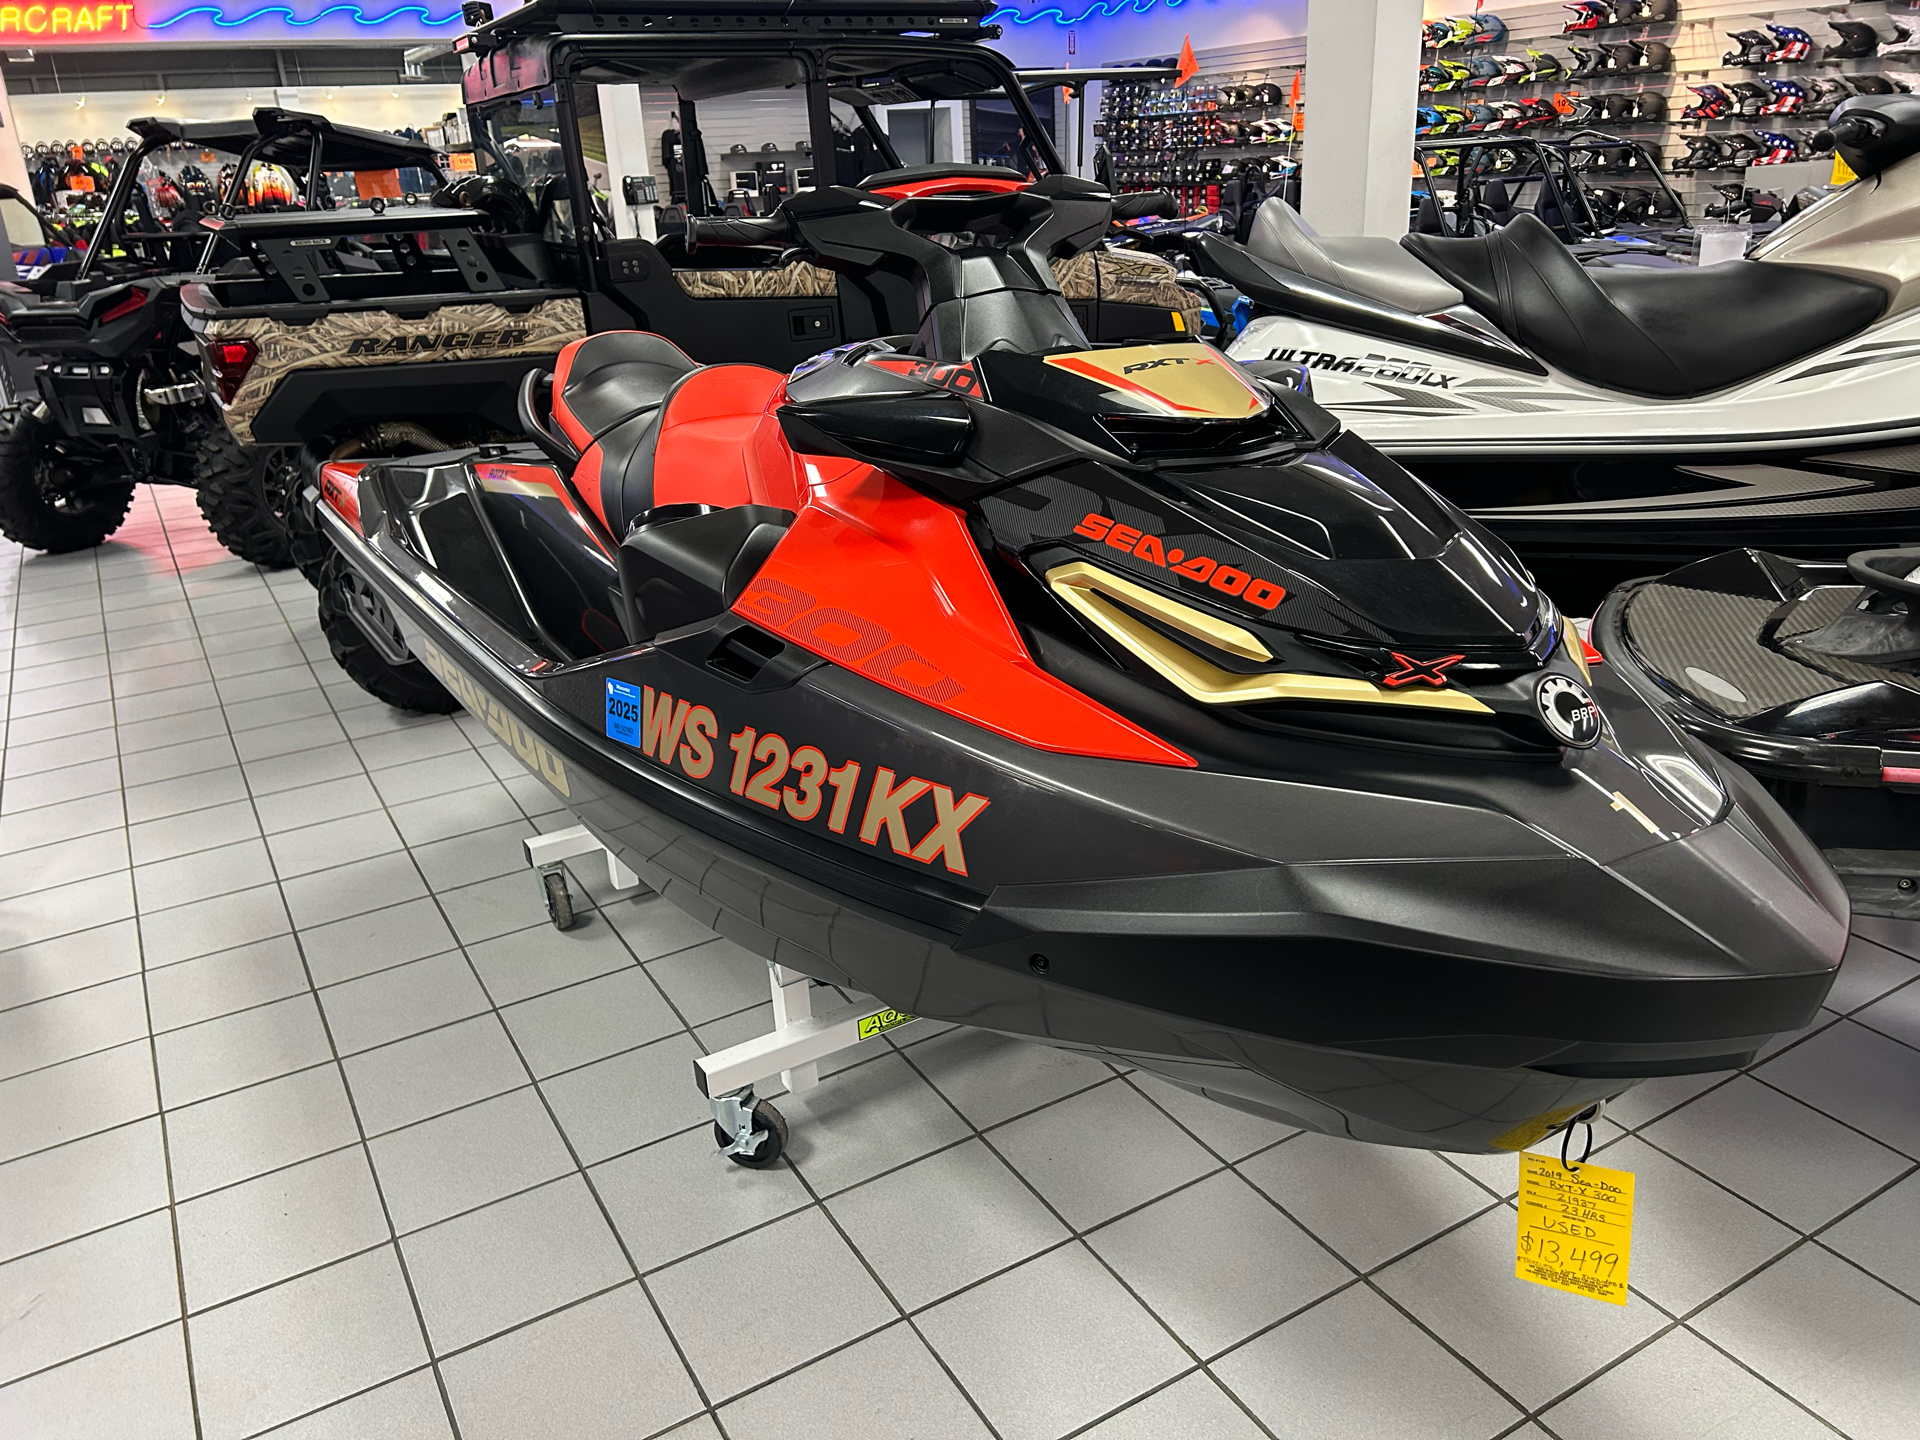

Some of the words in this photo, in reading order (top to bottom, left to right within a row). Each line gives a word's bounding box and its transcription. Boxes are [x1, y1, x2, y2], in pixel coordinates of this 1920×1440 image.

[1107, 261, 1169, 276] XP
[346, 328, 531, 356] RANGER
[1123, 357, 1190, 375] RXT
[907, 360, 979, 394] 300
[608, 697, 639, 723] 2025
[1571, 705, 1596, 722] BRP
[642, 684, 719, 780] WS
[729, 725, 861, 835] 1231
[859, 766, 992, 877] KX
[1539, 1167, 1562, 1180] 2019
[1593, 1190, 1617, 1203] 300
[1560, 1204, 1579, 1216] 23
[1582, 1209, 1605, 1223] HRS
[1543, 1216, 1596, 1238] USED
[1520, 1231, 1619, 1278] $13,499
